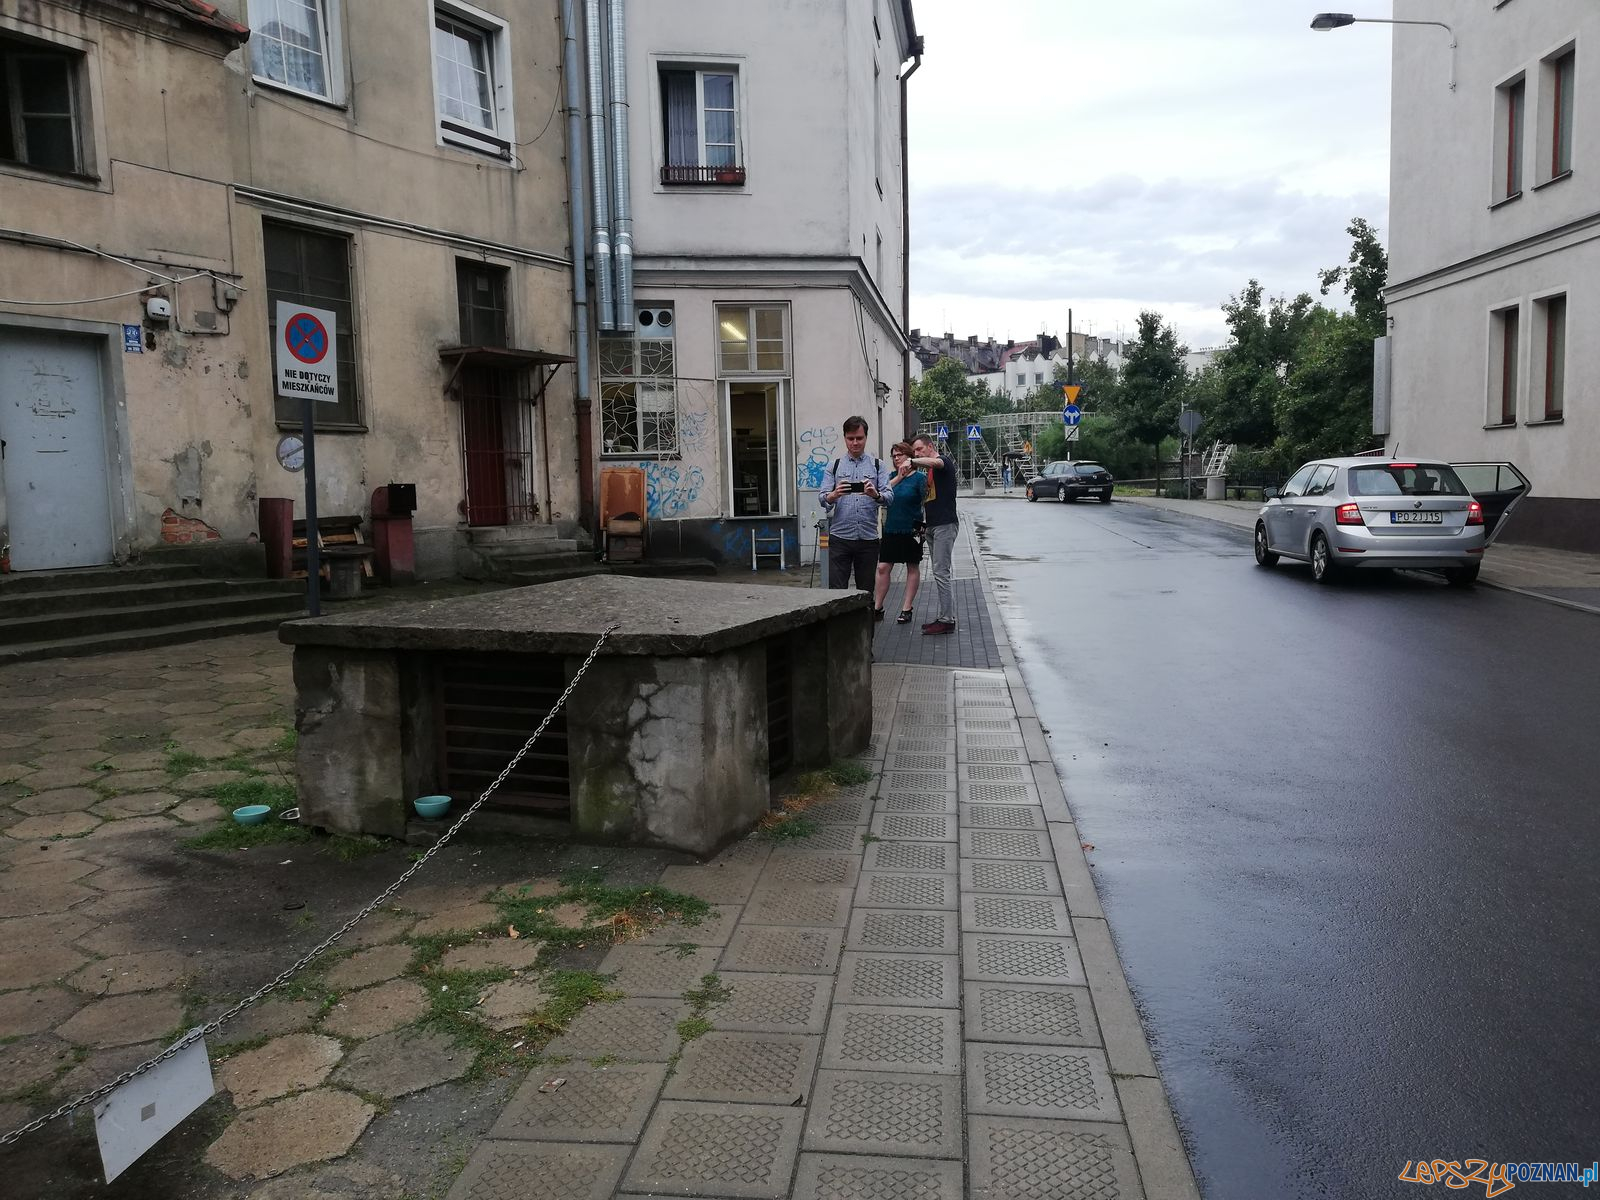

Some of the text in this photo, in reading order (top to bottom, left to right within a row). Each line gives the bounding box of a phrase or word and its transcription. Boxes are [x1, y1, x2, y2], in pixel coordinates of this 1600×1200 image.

[284, 369, 331, 383] NIE DOTYCZY
[282, 381, 335, 396] MIESZKAŃCÓW
[1397, 512, 1440, 521] PO 2JJ15
